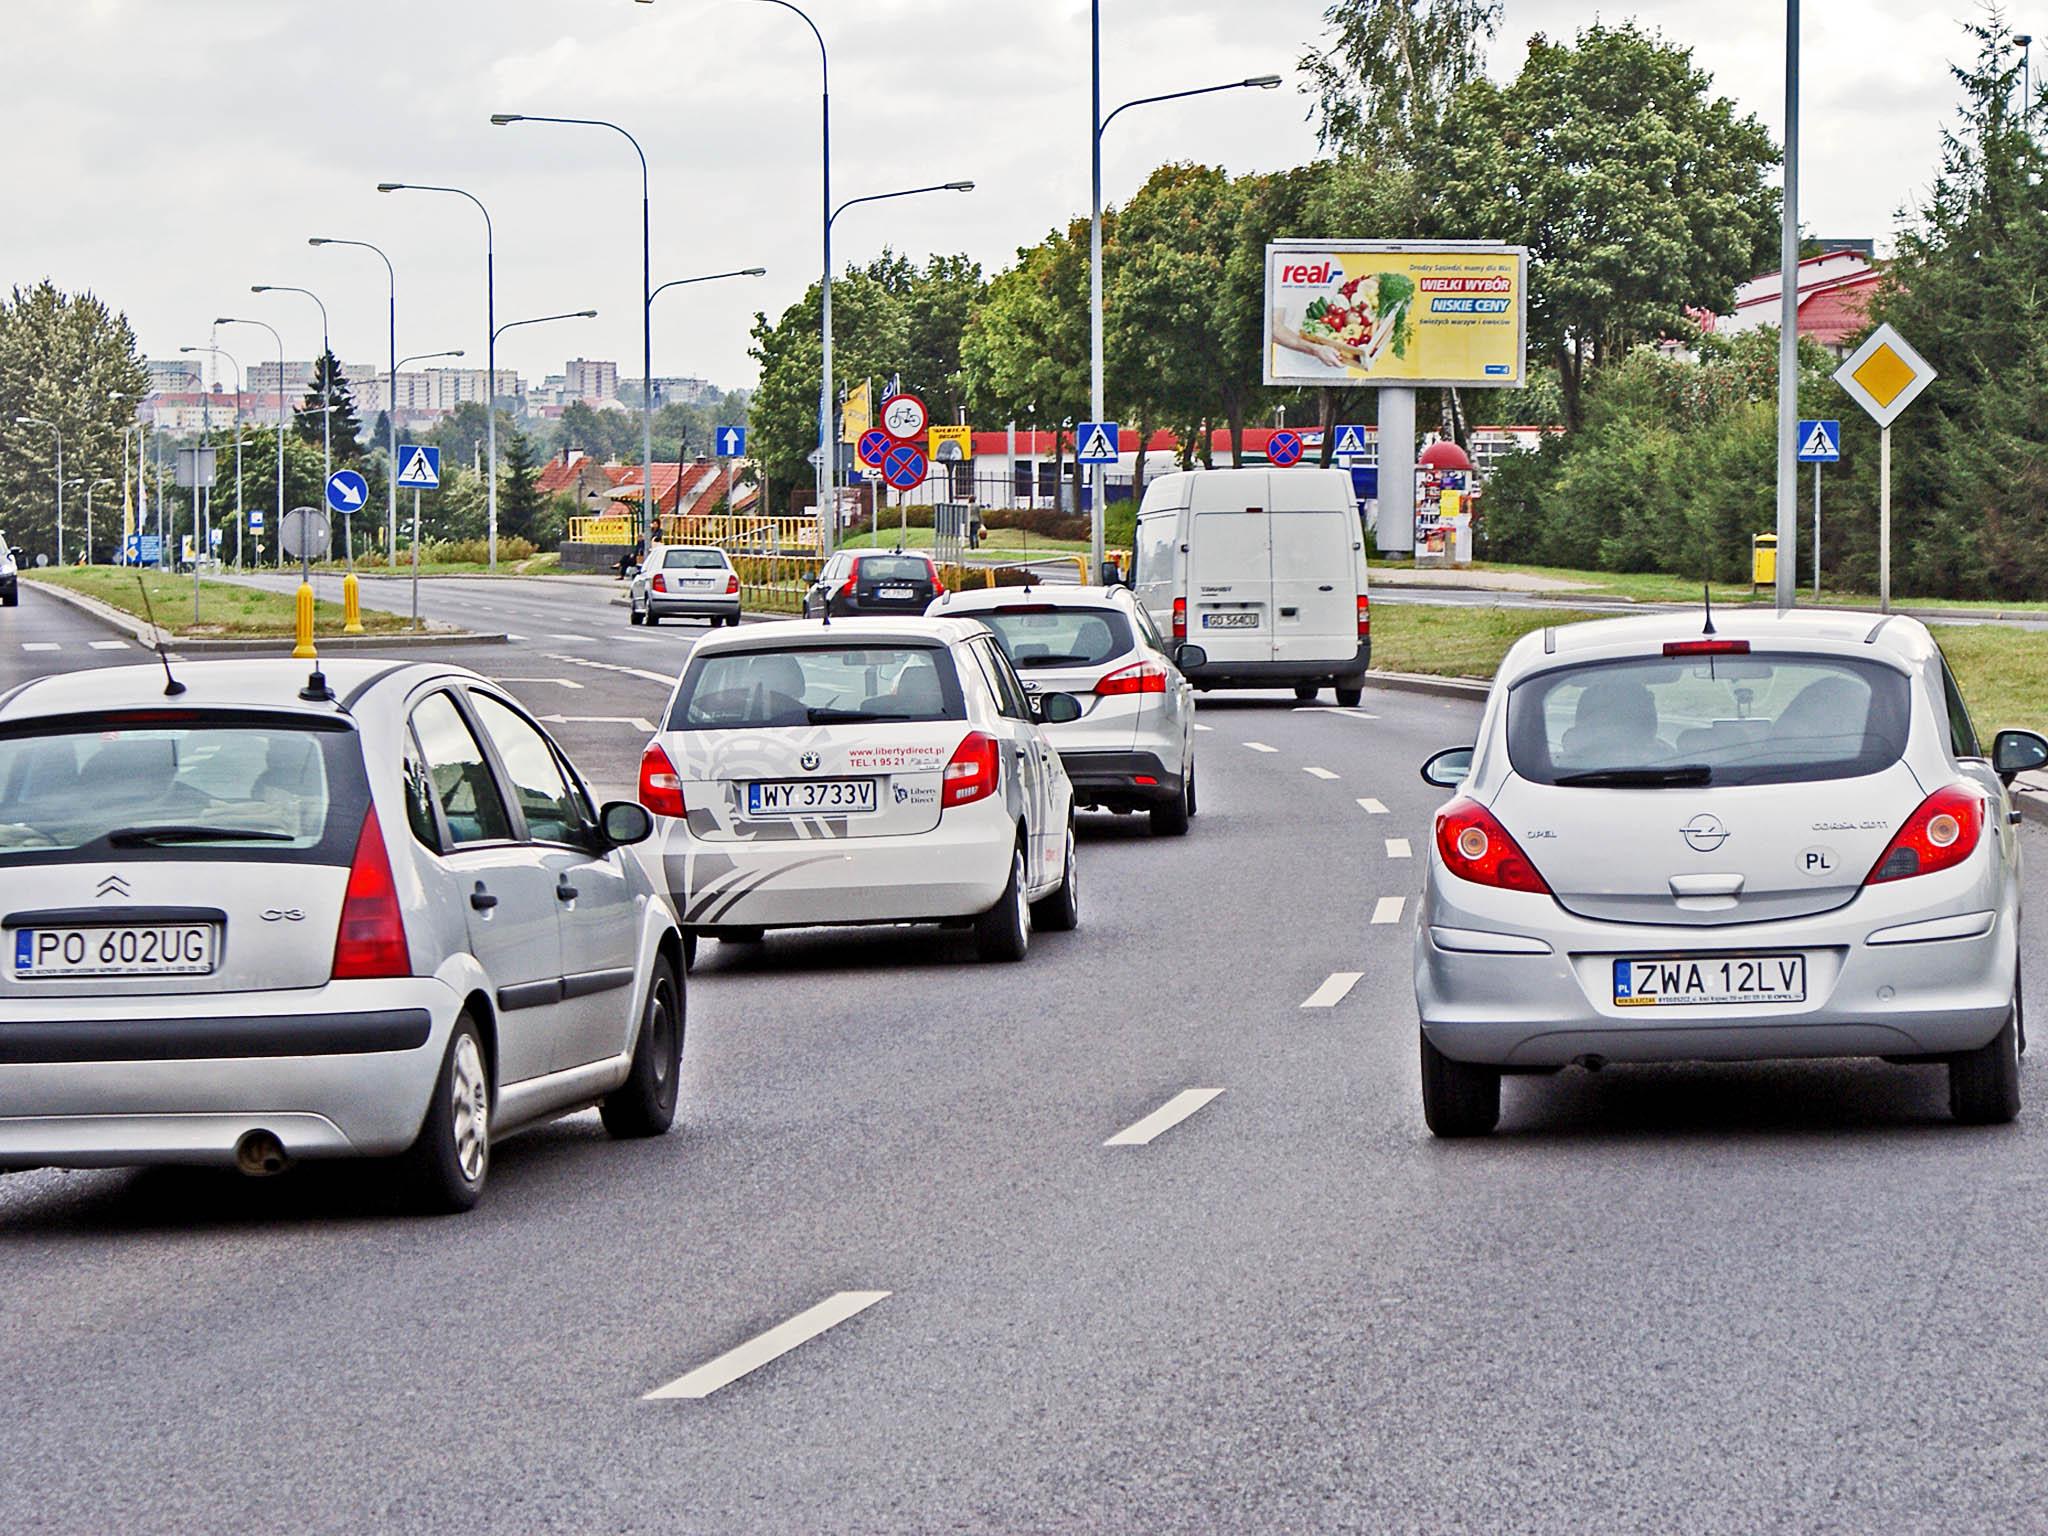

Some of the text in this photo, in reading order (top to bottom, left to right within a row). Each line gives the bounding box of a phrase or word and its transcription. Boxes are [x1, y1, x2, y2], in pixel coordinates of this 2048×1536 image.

[1421, 276, 1510, 291] WIELKI WYBÓR
[1432, 299, 1510, 311] NISKIE CENY
[849, 746, 945, 757] www.libertydirect.pl
[880, 758, 892, 766] 95
[894, 757, 905, 766] 21
[764, 783, 870, 807] WY 3733V
[1806, 852, 1831, 870] PL
[260, 909, 305, 921] C3
[38, 930, 203, 965] PO 602UG
[1637, 961, 1797, 994] ZWA 12LV
[1618, 984, 1630, 993] PL
